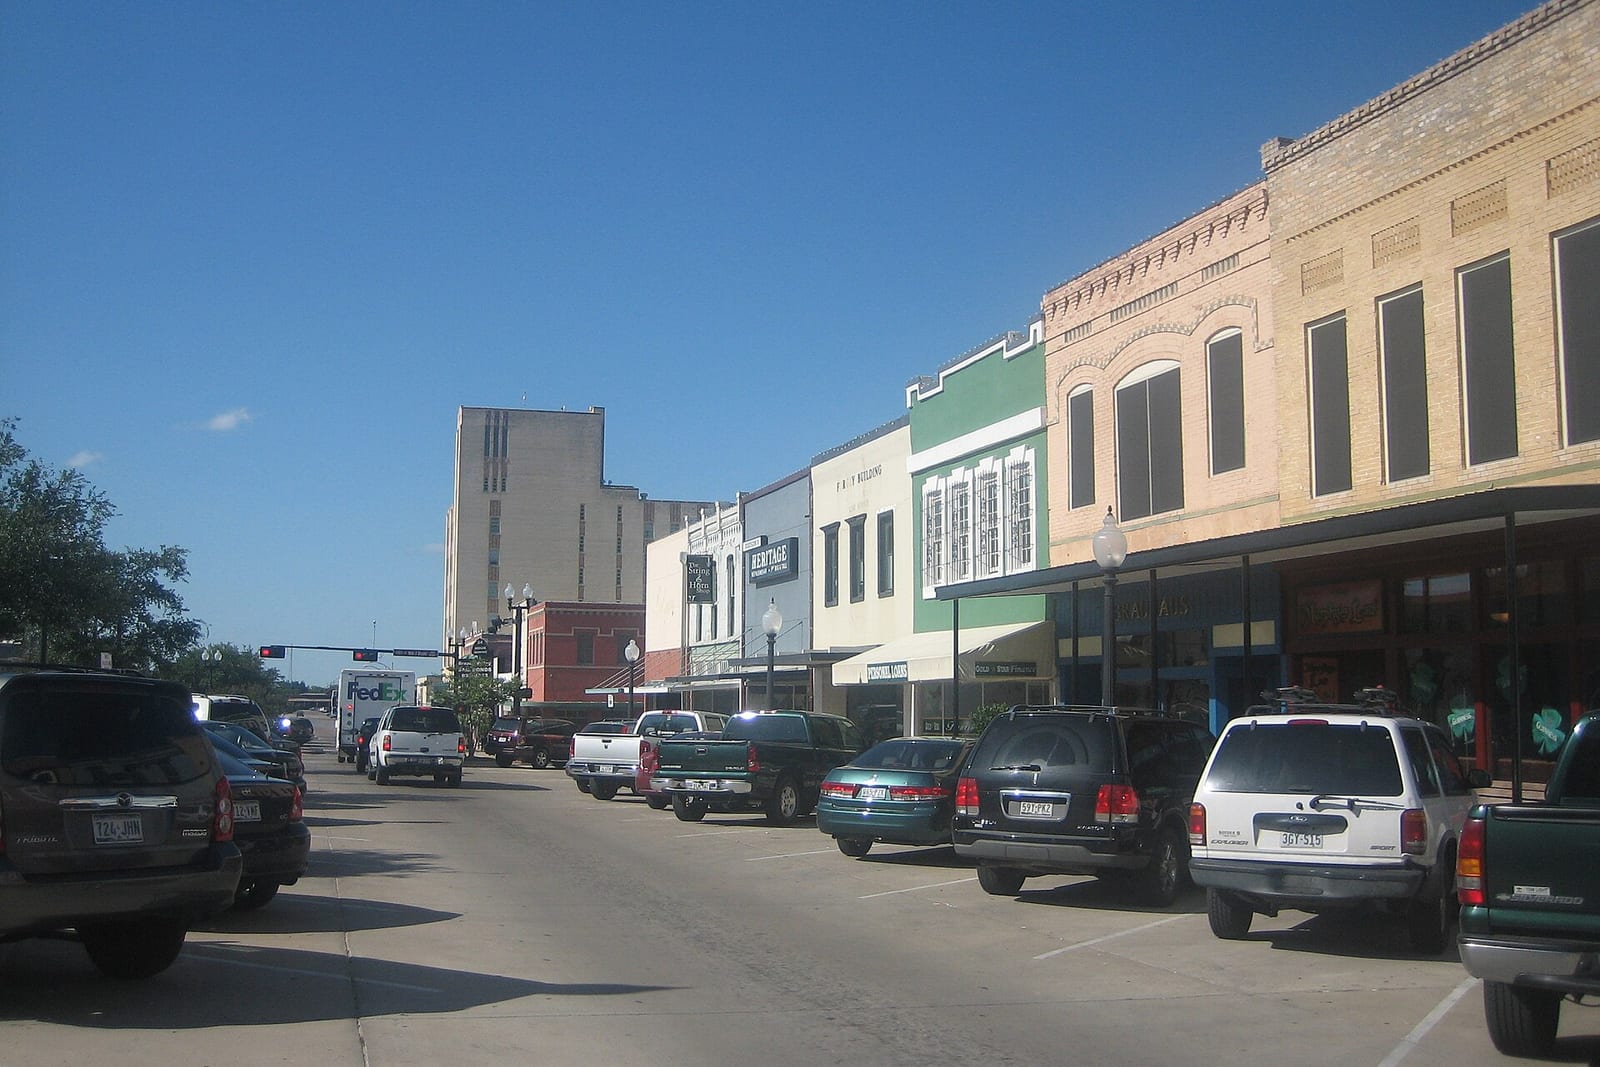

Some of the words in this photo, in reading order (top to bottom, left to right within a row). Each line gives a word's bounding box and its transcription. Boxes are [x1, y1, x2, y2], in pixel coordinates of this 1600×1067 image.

[857, 464, 882, 484] BUILDING
[751, 544, 787, 570] HERITAGE
[688, 567, 711, 576] String
[867, 664, 891, 680] PERSONAL
[891, 663, 908, 679] LOANS
[347, 681, 407, 701] FedEx
[1509, 893, 1584, 905] SILVERADO
